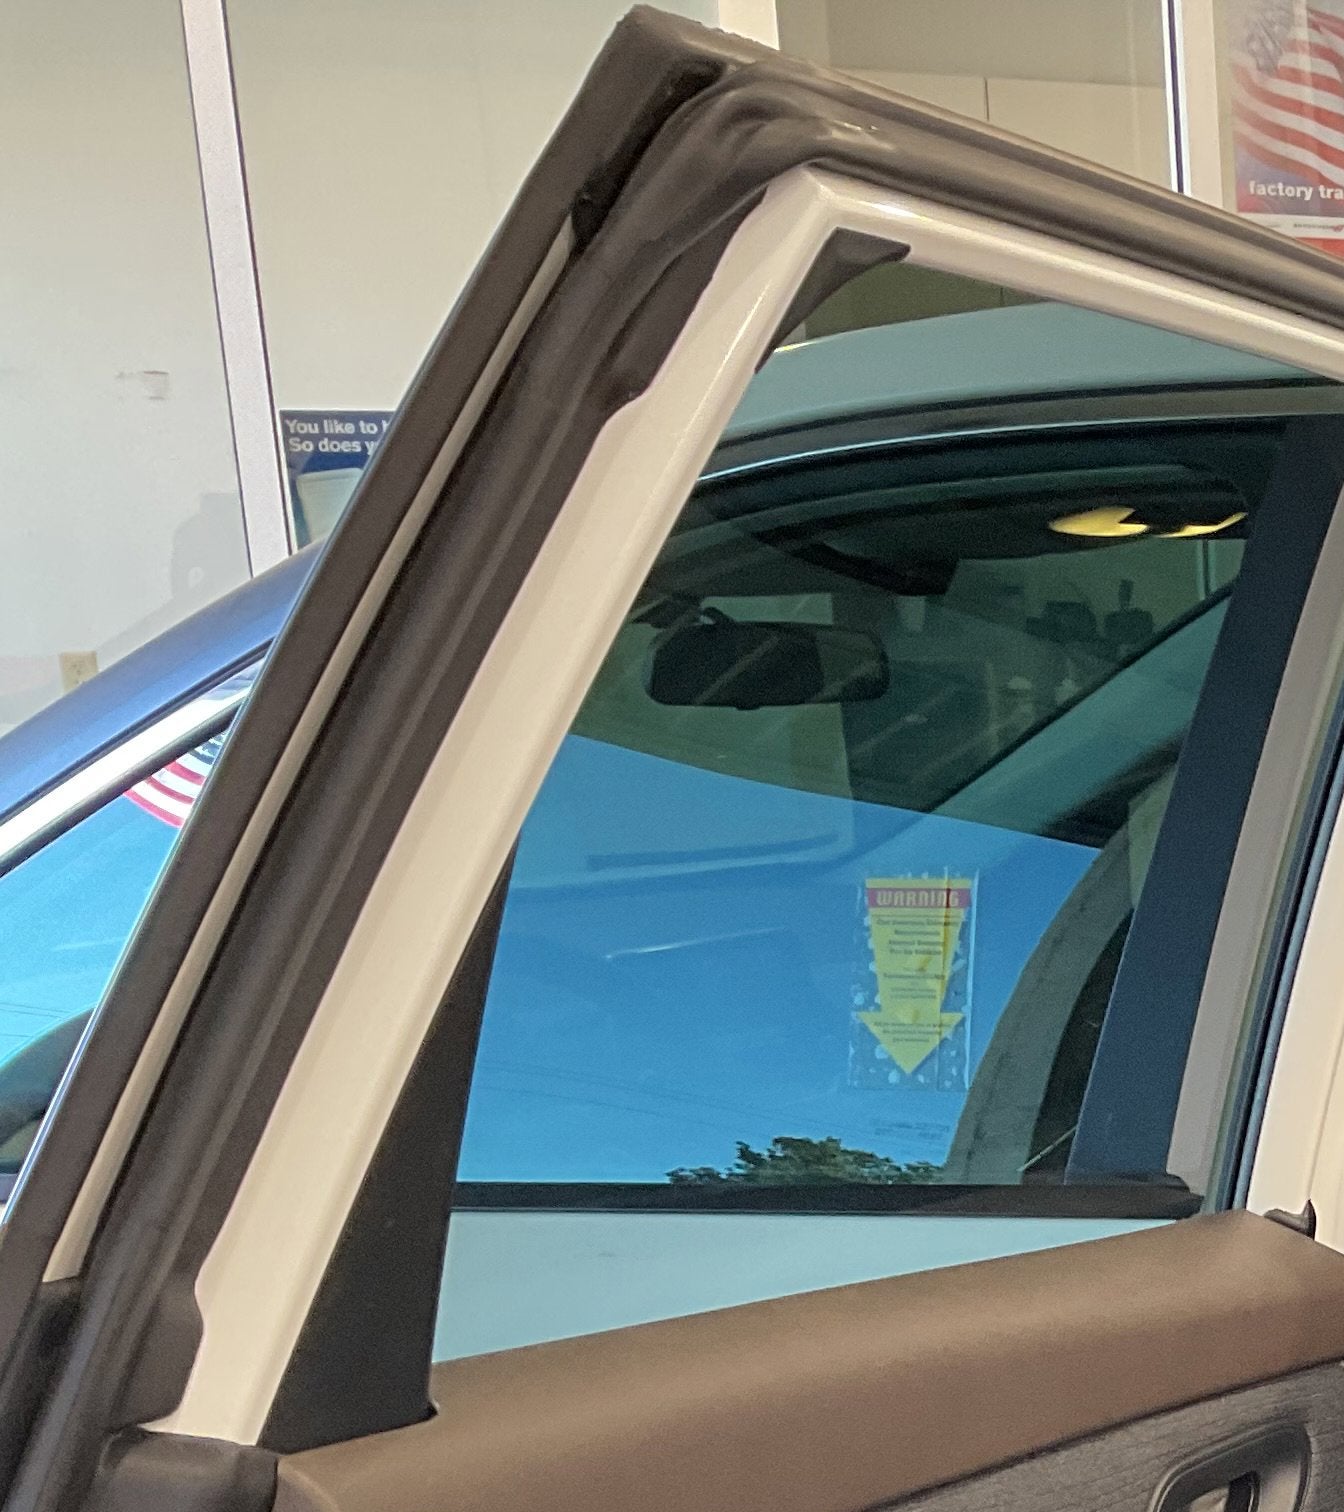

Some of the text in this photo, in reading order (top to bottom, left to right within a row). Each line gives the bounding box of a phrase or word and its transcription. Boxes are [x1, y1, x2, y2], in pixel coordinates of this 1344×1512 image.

[1249, 181, 1312, 201] factory
[284, 419, 319, 434] You
[324, 419, 355, 434] like
[360, 420, 378, 434] to
[289, 438, 314, 452] So
[319, 437, 361, 452] does
[877, 890, 959, 906] WARNING
